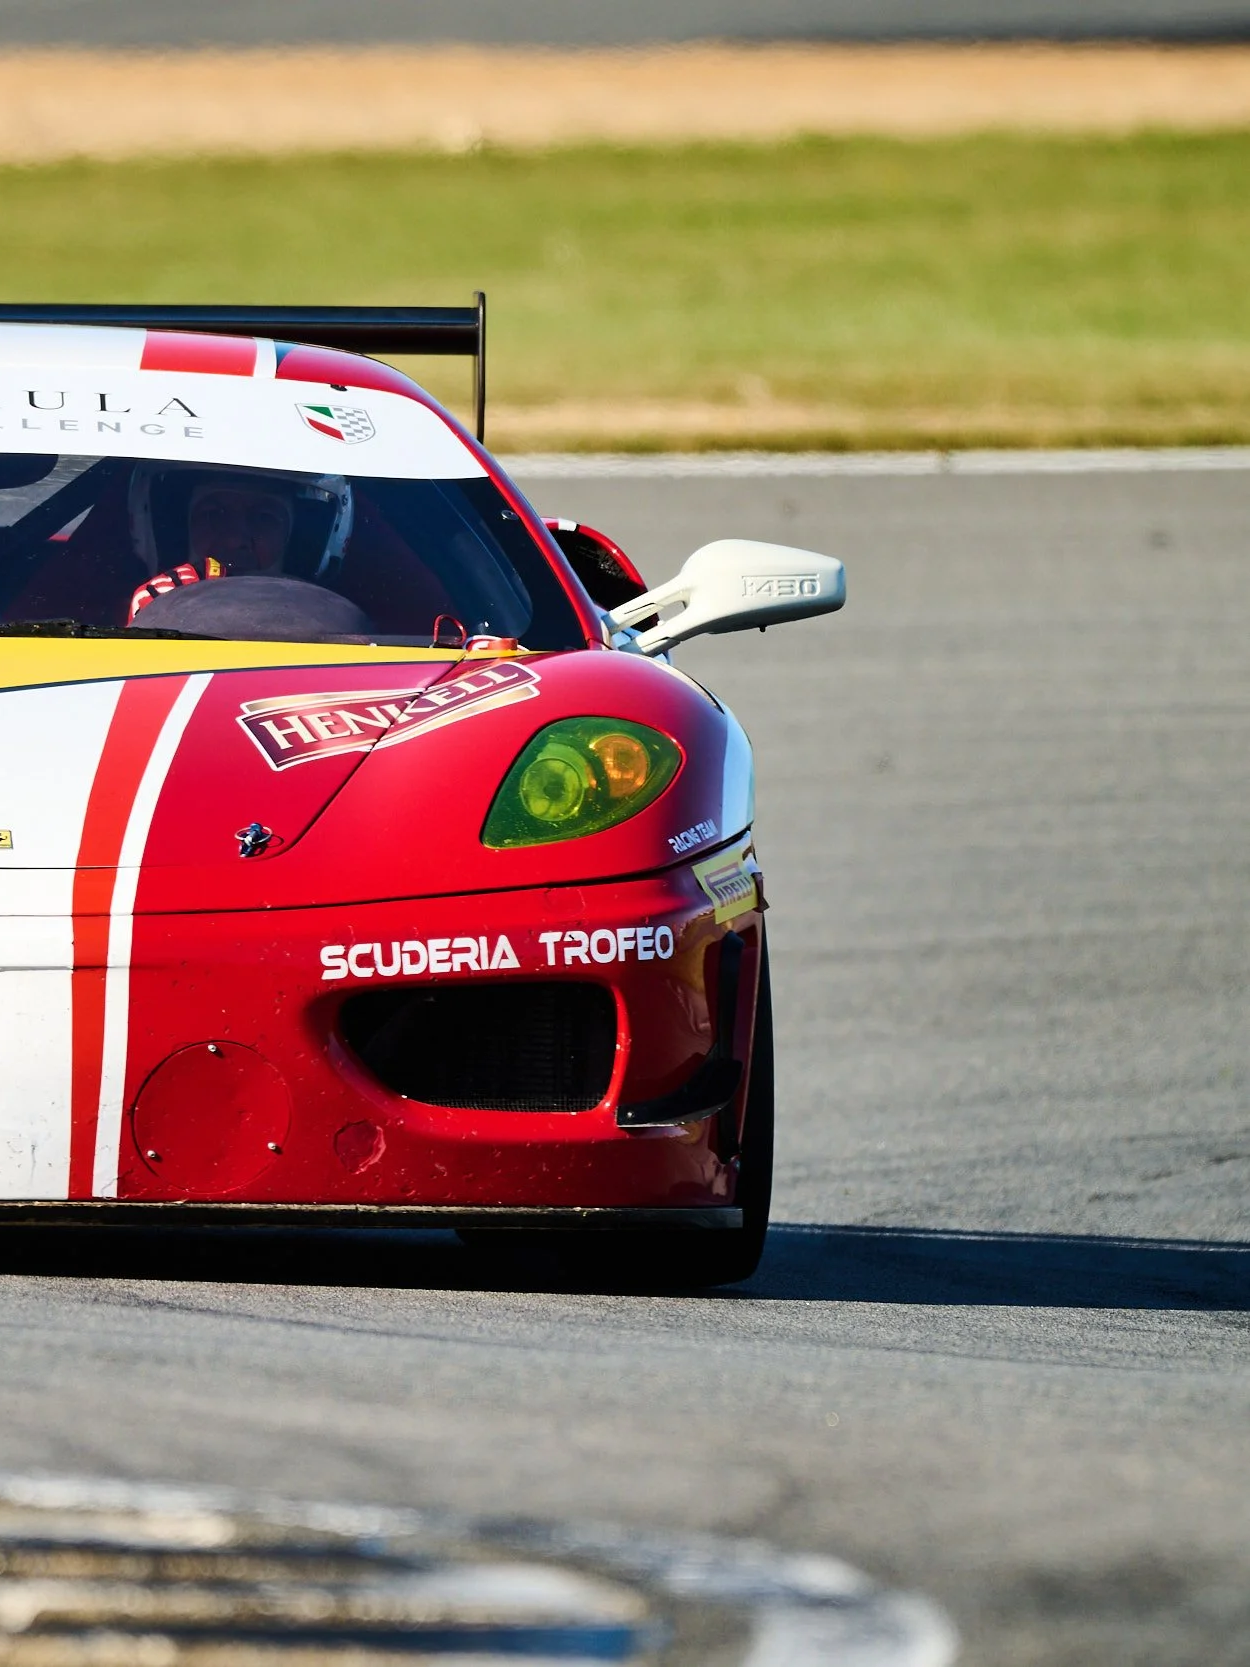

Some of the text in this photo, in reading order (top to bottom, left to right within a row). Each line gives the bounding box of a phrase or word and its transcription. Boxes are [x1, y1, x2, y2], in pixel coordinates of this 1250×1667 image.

[259, 670, 519, 751] HENKELL
[667, 818, 719, 854] RACING TEAM
[319, 925, 674, 981] SCUDERIA TROFEO
